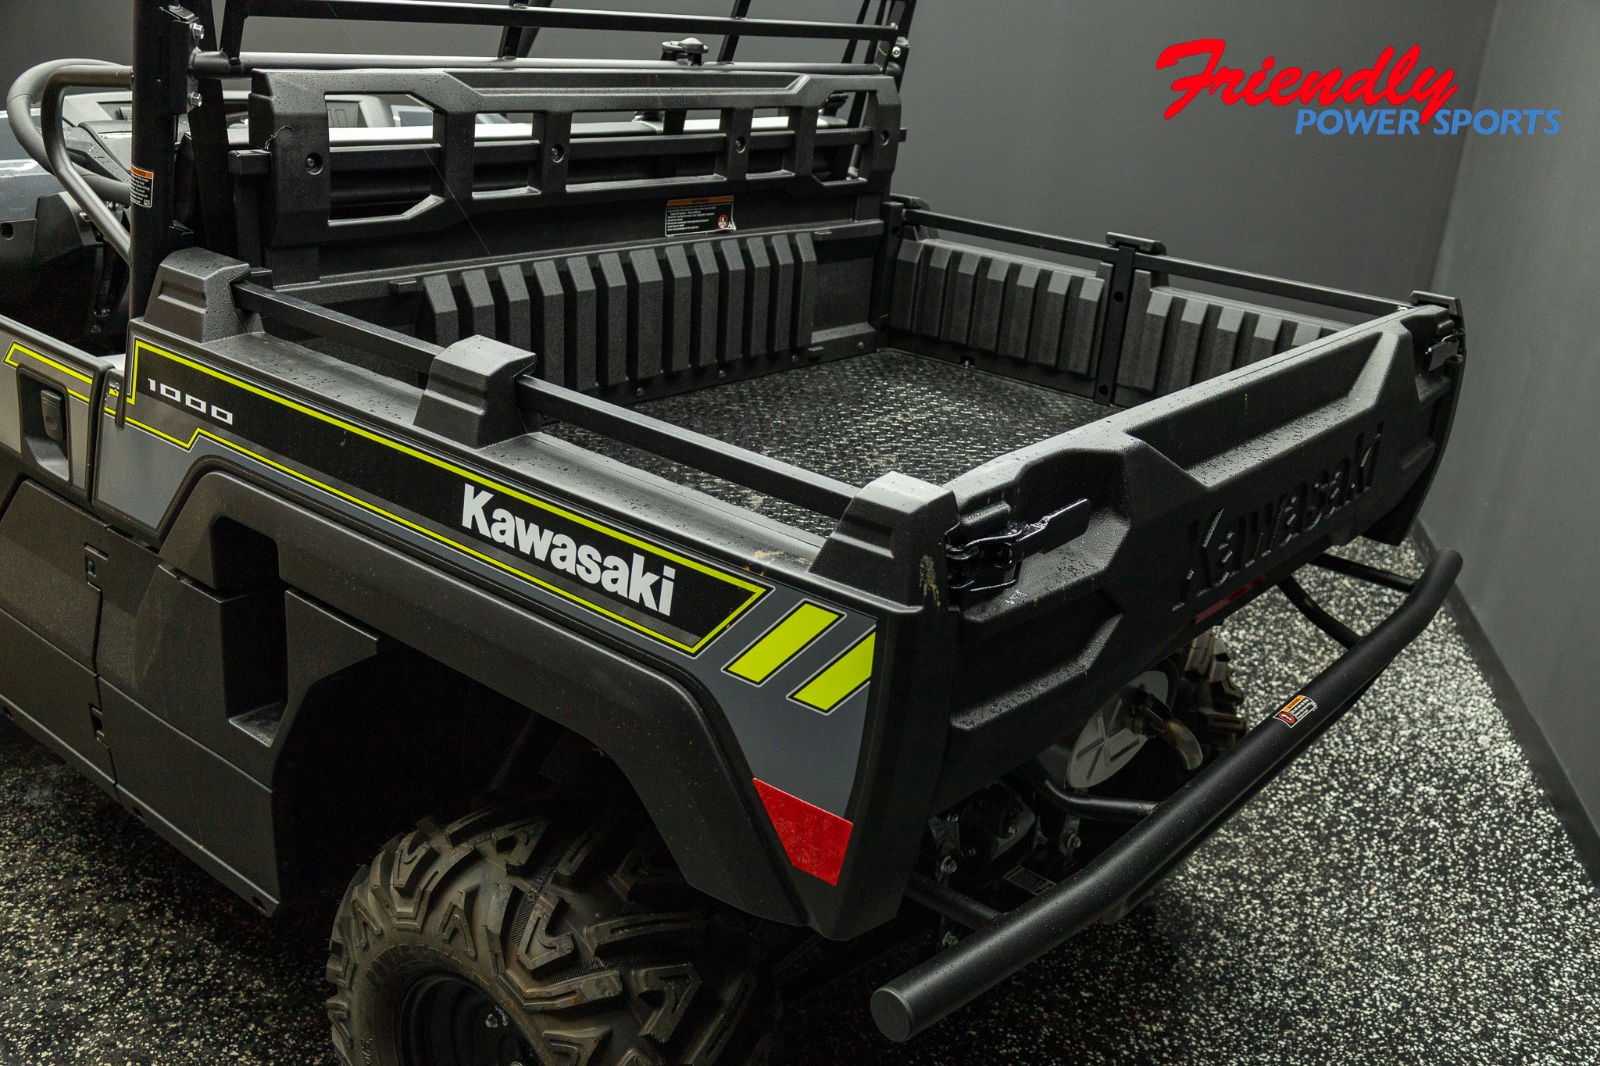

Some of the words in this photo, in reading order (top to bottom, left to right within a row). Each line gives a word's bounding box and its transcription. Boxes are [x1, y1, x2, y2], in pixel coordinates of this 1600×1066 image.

[147, 377, 233, 426] 1000
[461, 483, 676, 617] Kawasaki
[1172, 421, 1384, 613] Kawasaki
